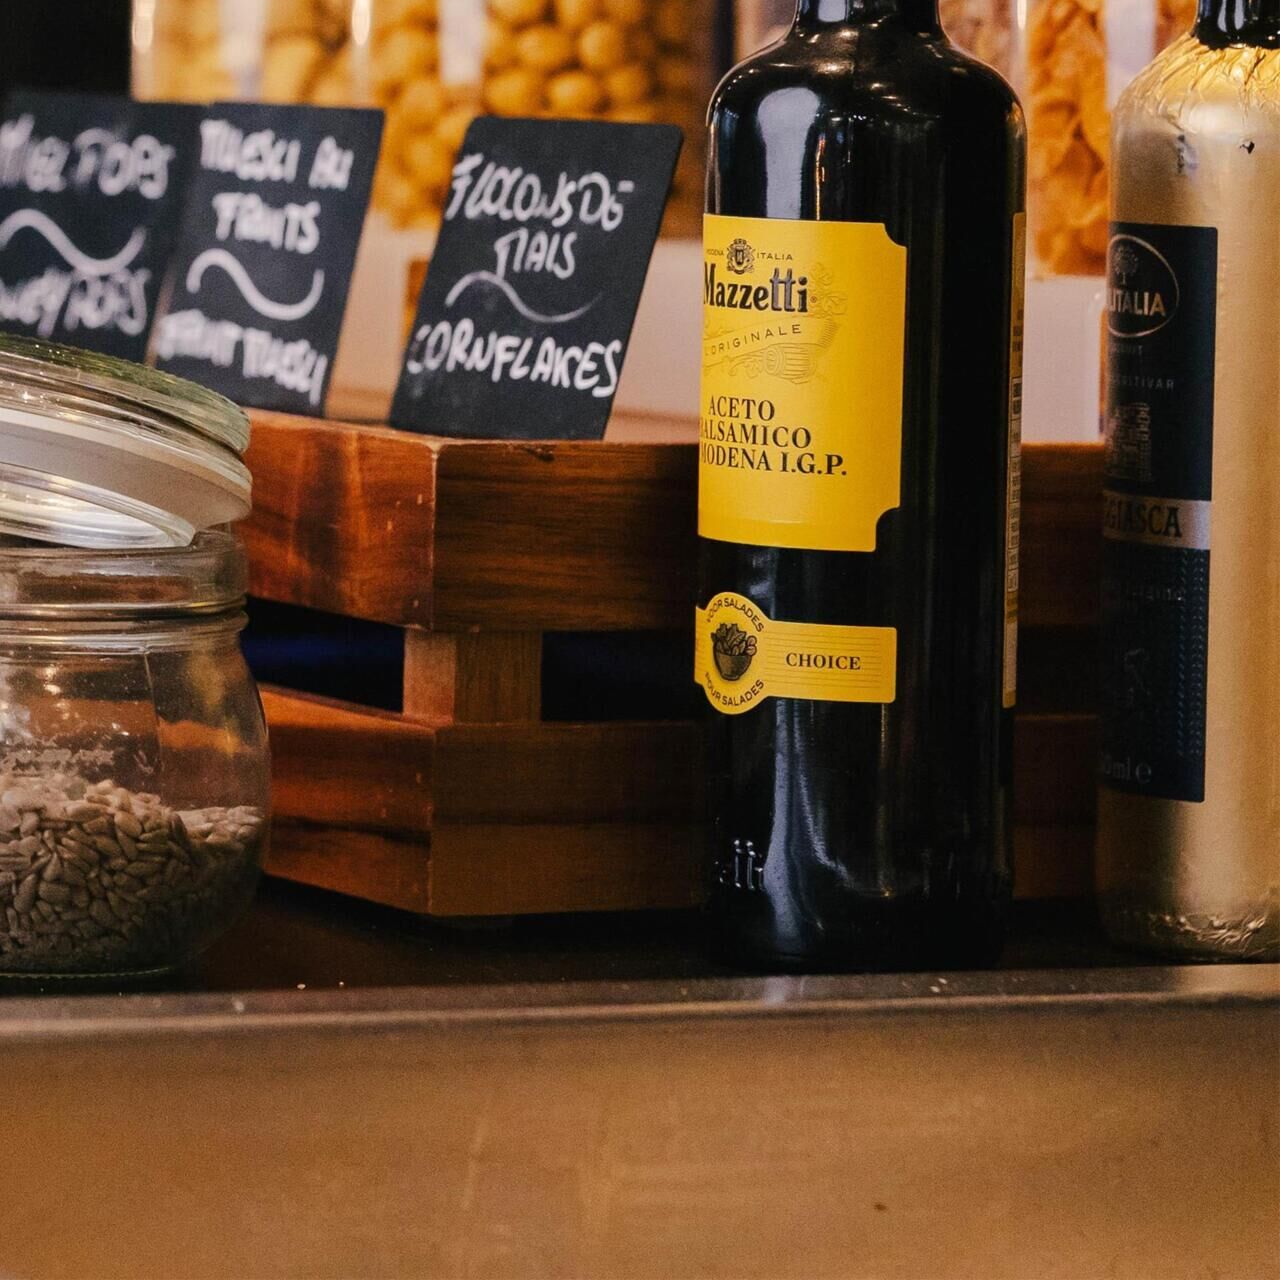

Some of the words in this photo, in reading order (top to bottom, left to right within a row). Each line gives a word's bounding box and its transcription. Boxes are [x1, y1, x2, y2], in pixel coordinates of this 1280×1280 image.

[444, 153, 579, 227] FLOCONS
[756, 252, 794, 261] ITALIA
[704, 262, 808, 313] Mazzetti
[407, 318, 622, 398] CORNFLAKES
[709, 395, 775, 421] ACETO
[780, 451, 847, 476] I.G.P.
[724, 597, 765, 633] SALADES
[786, 652, 861, 671] CHOICE
[722, 679, 765, 707] SALADES
